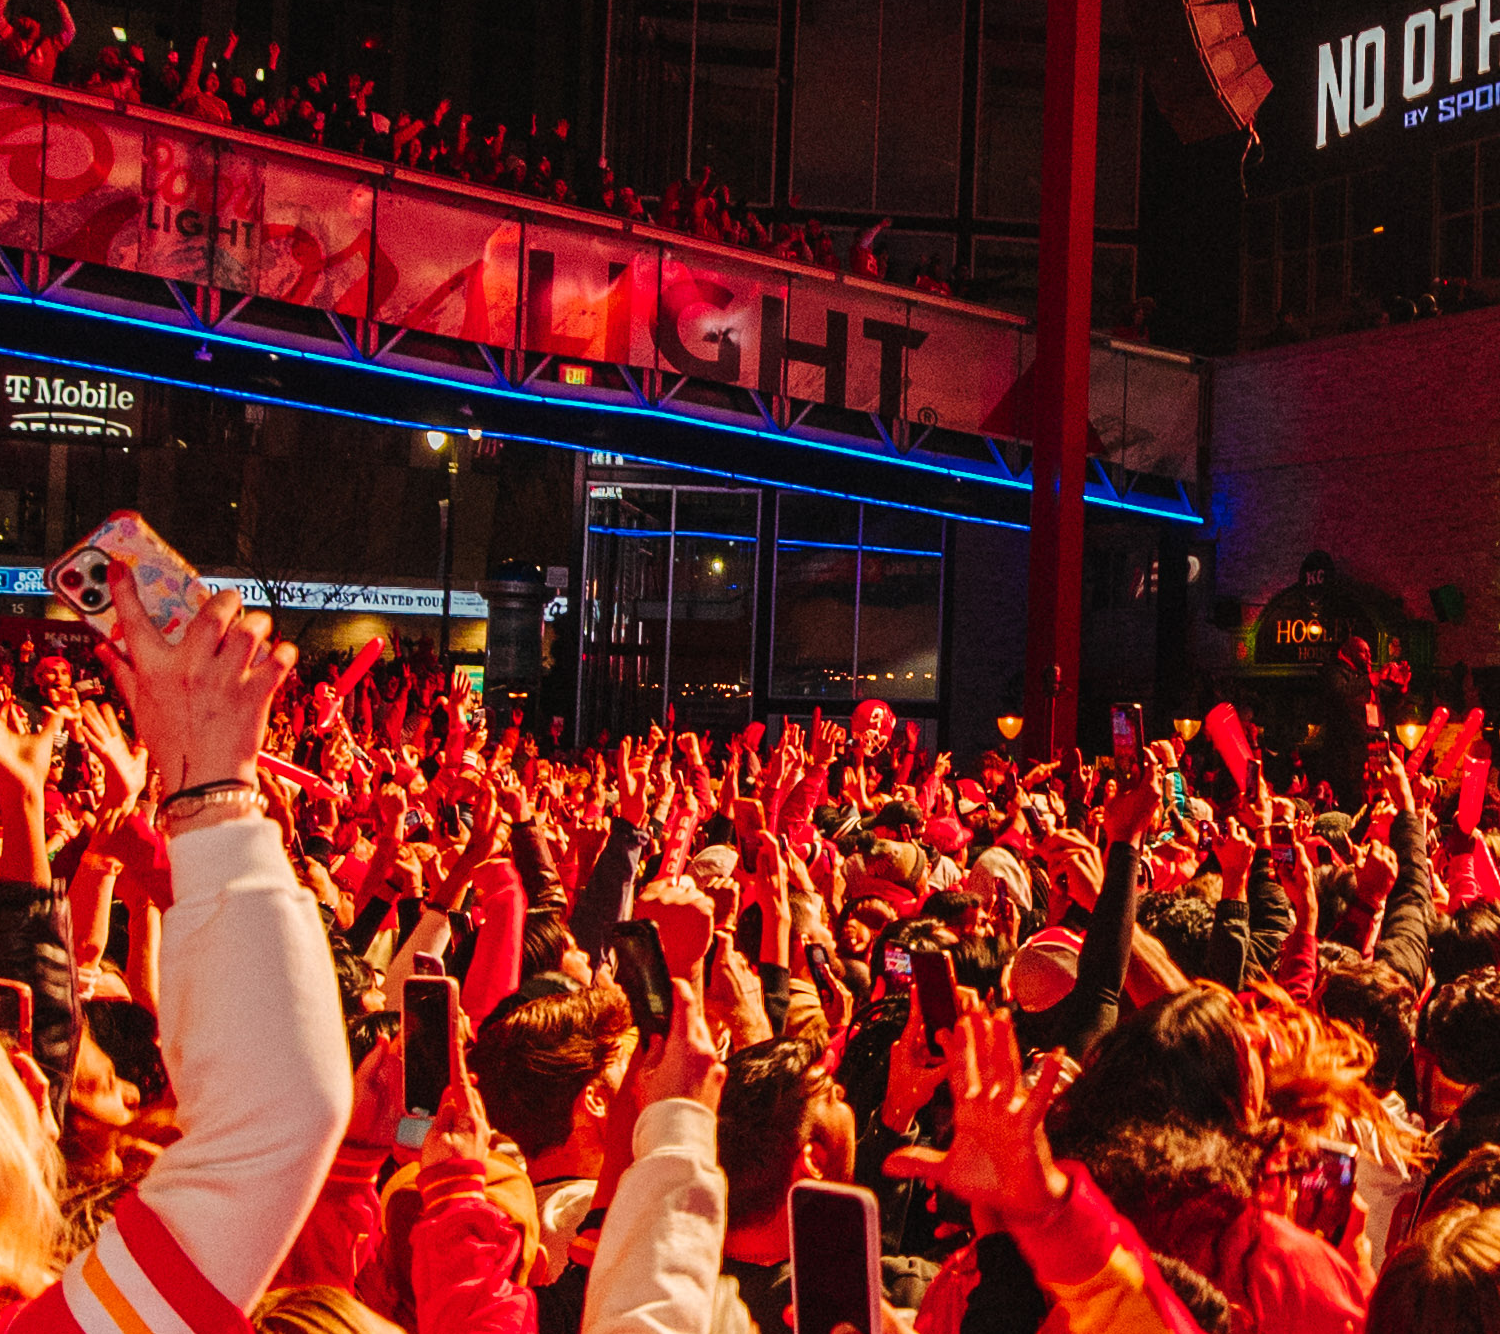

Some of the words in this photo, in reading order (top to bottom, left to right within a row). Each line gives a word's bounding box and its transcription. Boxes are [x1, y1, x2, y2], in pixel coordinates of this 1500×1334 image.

[1315, 25, 1387, 150] NO
[1403, 106, 1430, 129] BY
[147, 200, 255, 249] LIGHT
[525, 248, 929, 408] LIGHT
[362, 592, 414, 607] WANTED
[416, 595, 445, 609] TOU
